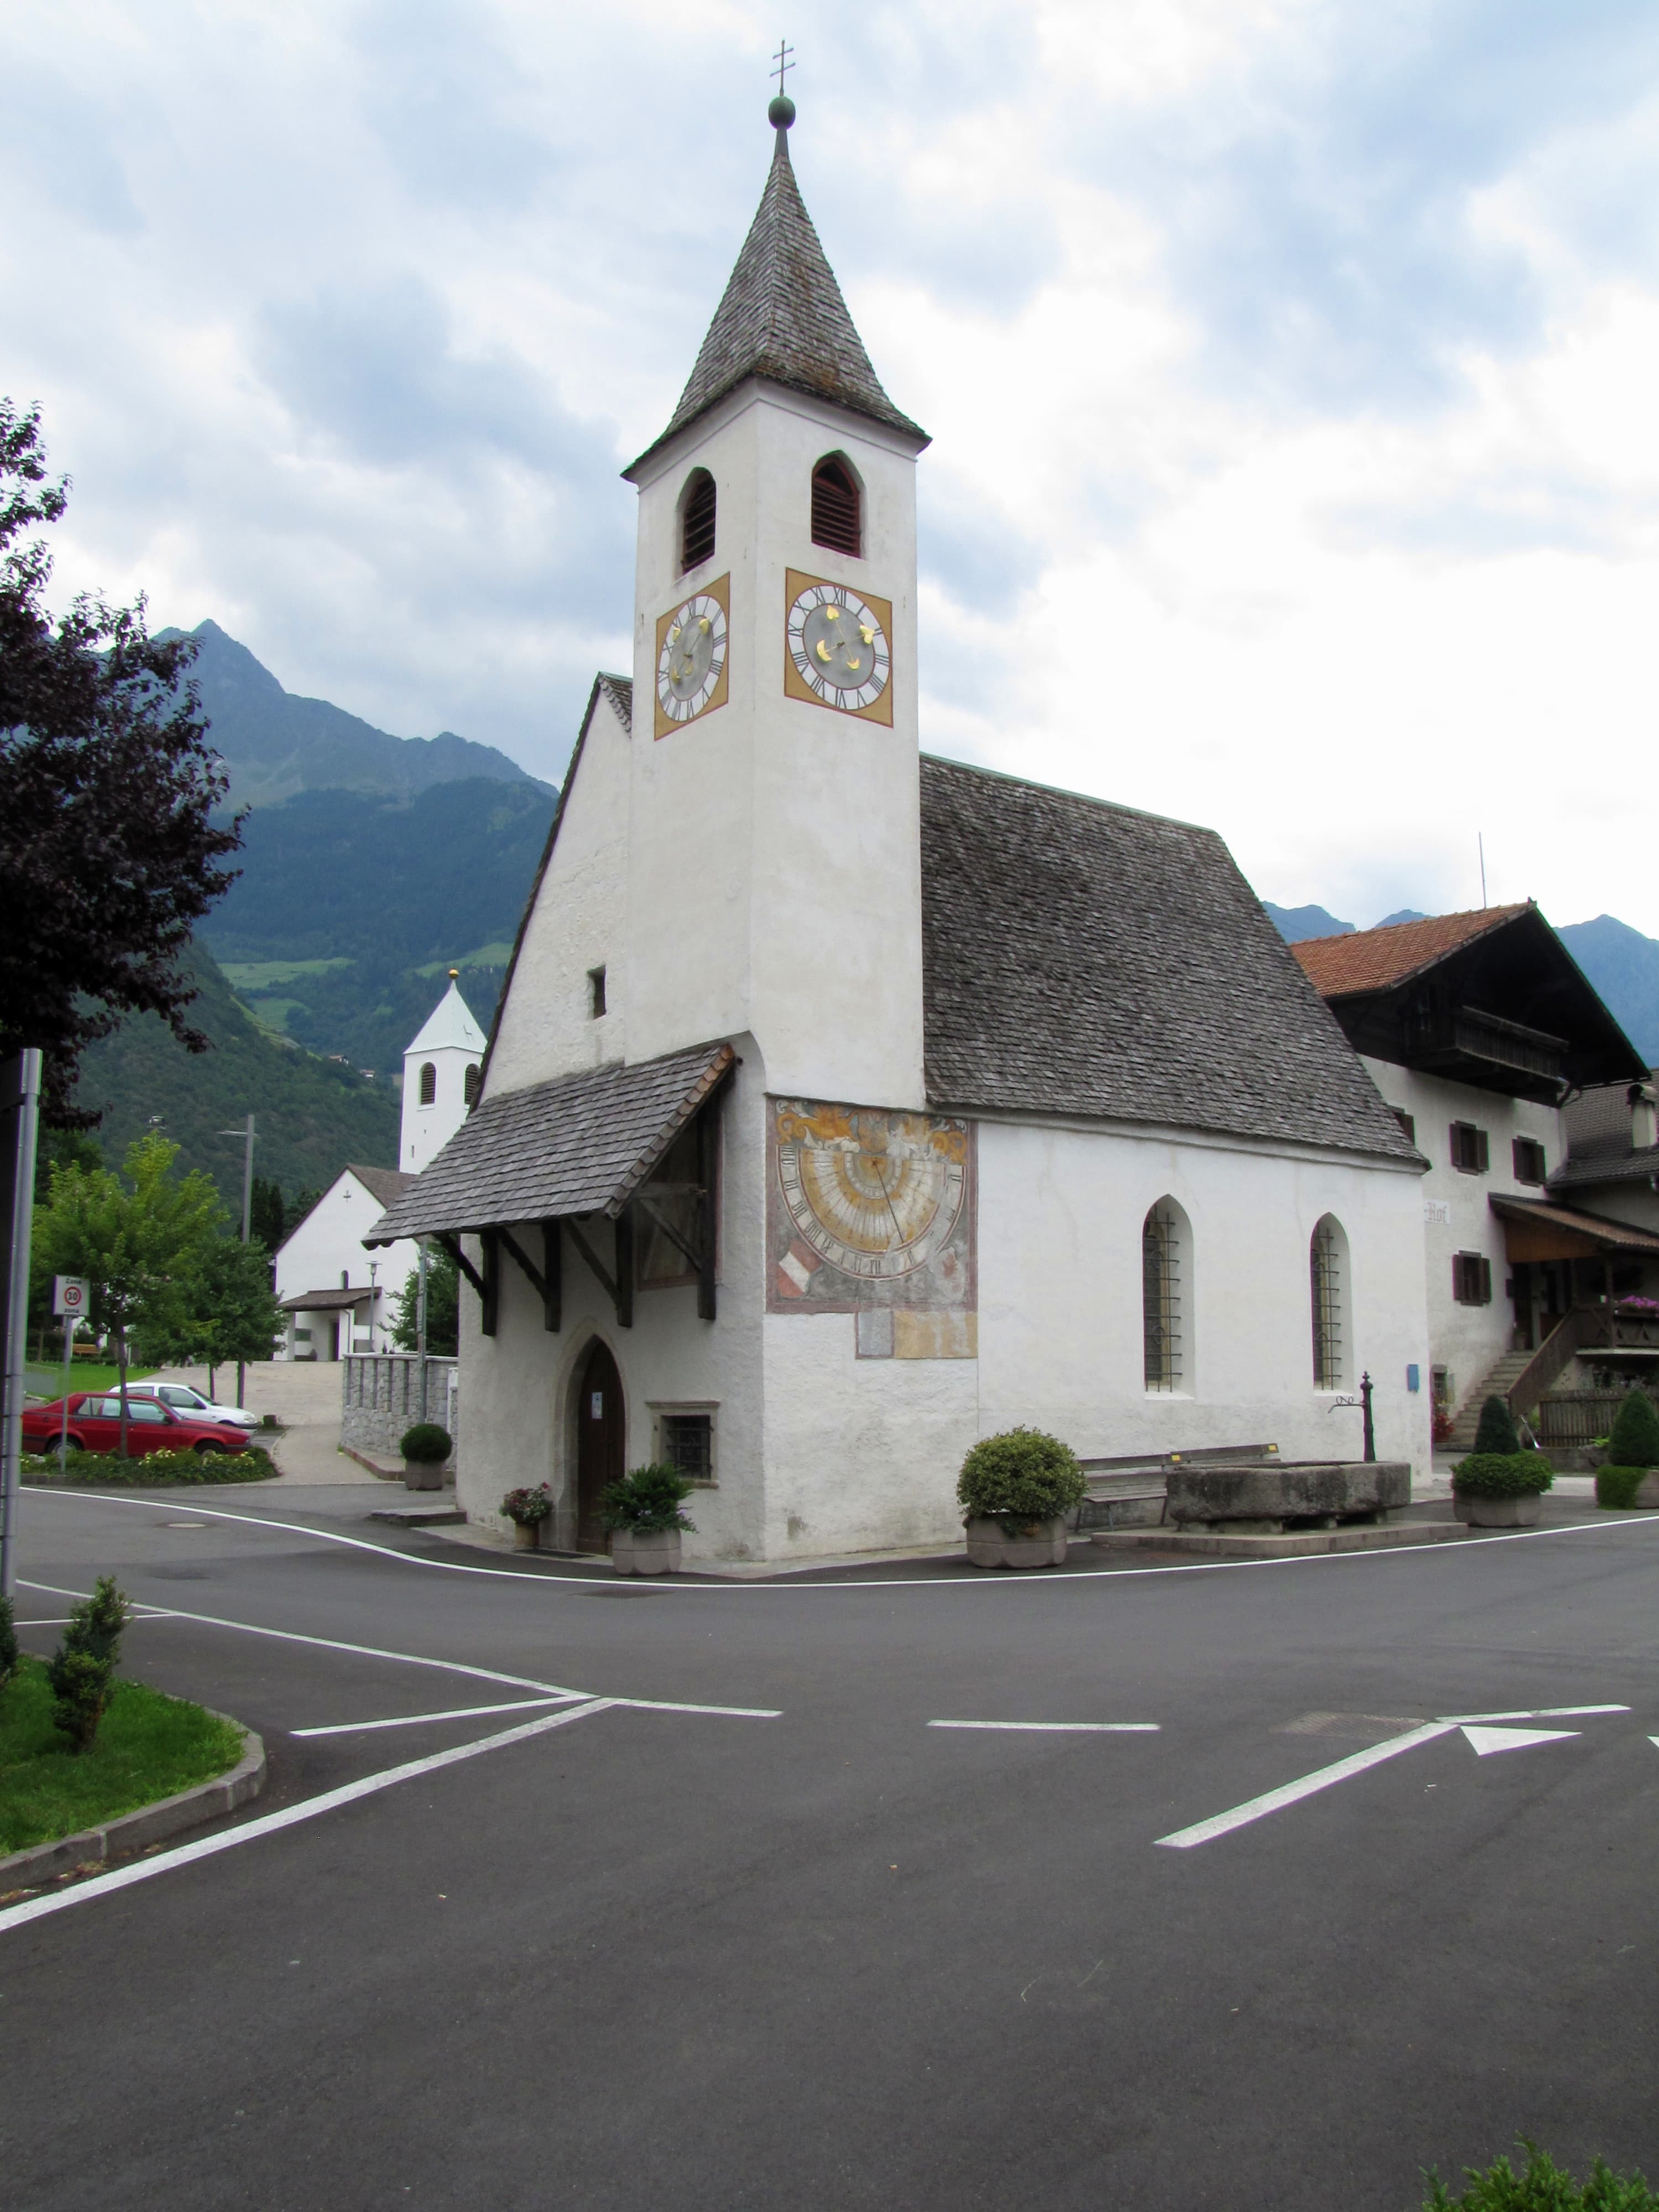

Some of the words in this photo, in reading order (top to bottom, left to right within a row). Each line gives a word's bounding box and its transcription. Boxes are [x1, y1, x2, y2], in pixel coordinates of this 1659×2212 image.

[810, 586, 826, 607] XI
[833, 587, 846, 608] XII
[703, 597, 710, 615] I
[792, 599, 812, 616] X
[855, 603, 865, 616] I
[711, 608, 723, 627] II
[787, 623, 804, 637] IX
[662, 640, 674, 656] X
[713, 632, 726, 648] III
[709, 659, 723, 675] IIII
[792, 651, 810, 674] VIII
[875, 654, 888, 667] III
[810, 675, 825, 700] VII
[868, 674, 885, 694] IIII
[702, 686, 710, 706] V
[835, 688, 847, 708] VI
[857, 688, 867, 708] V
[68, 1292, 78, 1301] 30
